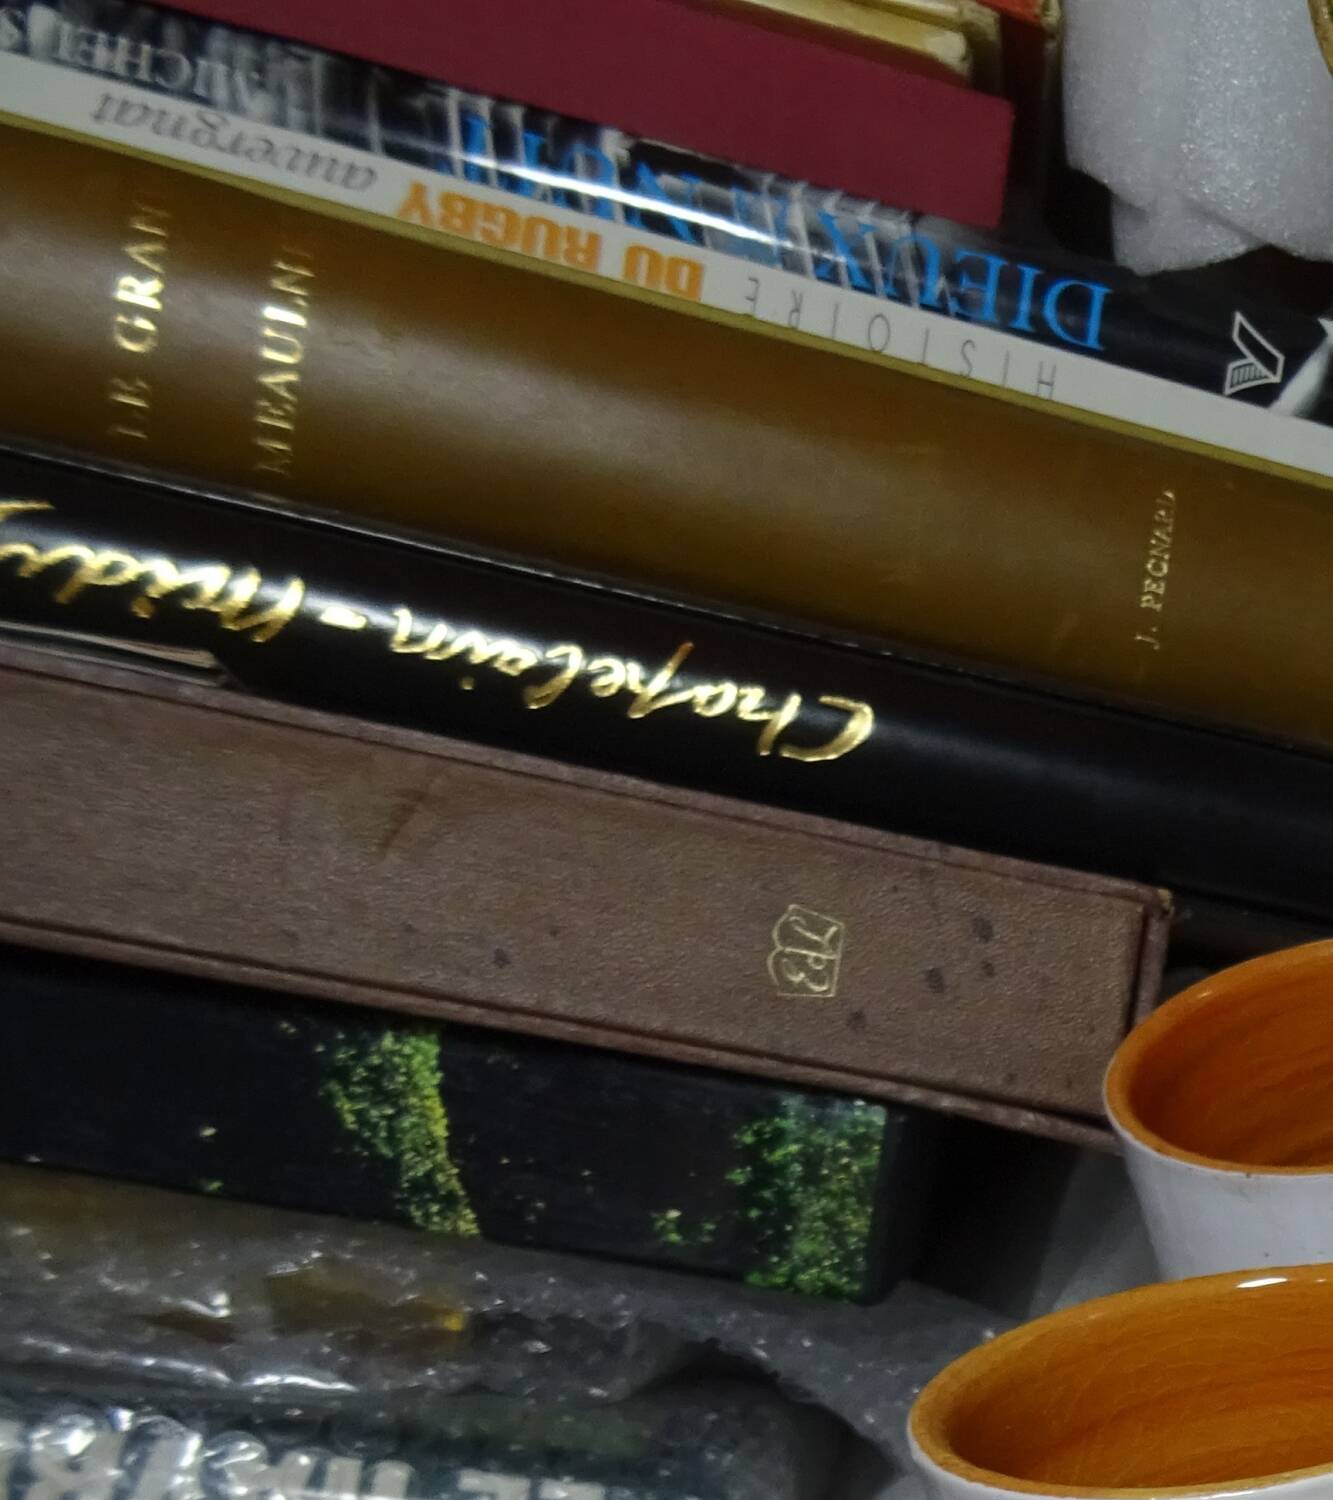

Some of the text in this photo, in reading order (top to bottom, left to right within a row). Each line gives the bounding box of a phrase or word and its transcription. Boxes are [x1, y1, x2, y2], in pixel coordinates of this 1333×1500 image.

[94, 92, 1058, 404] HISTOIRE DU RUGBY auvergnat
[111, 202, 174, 356] GRAN
[813, 209, 1114, 352] DIEUX
